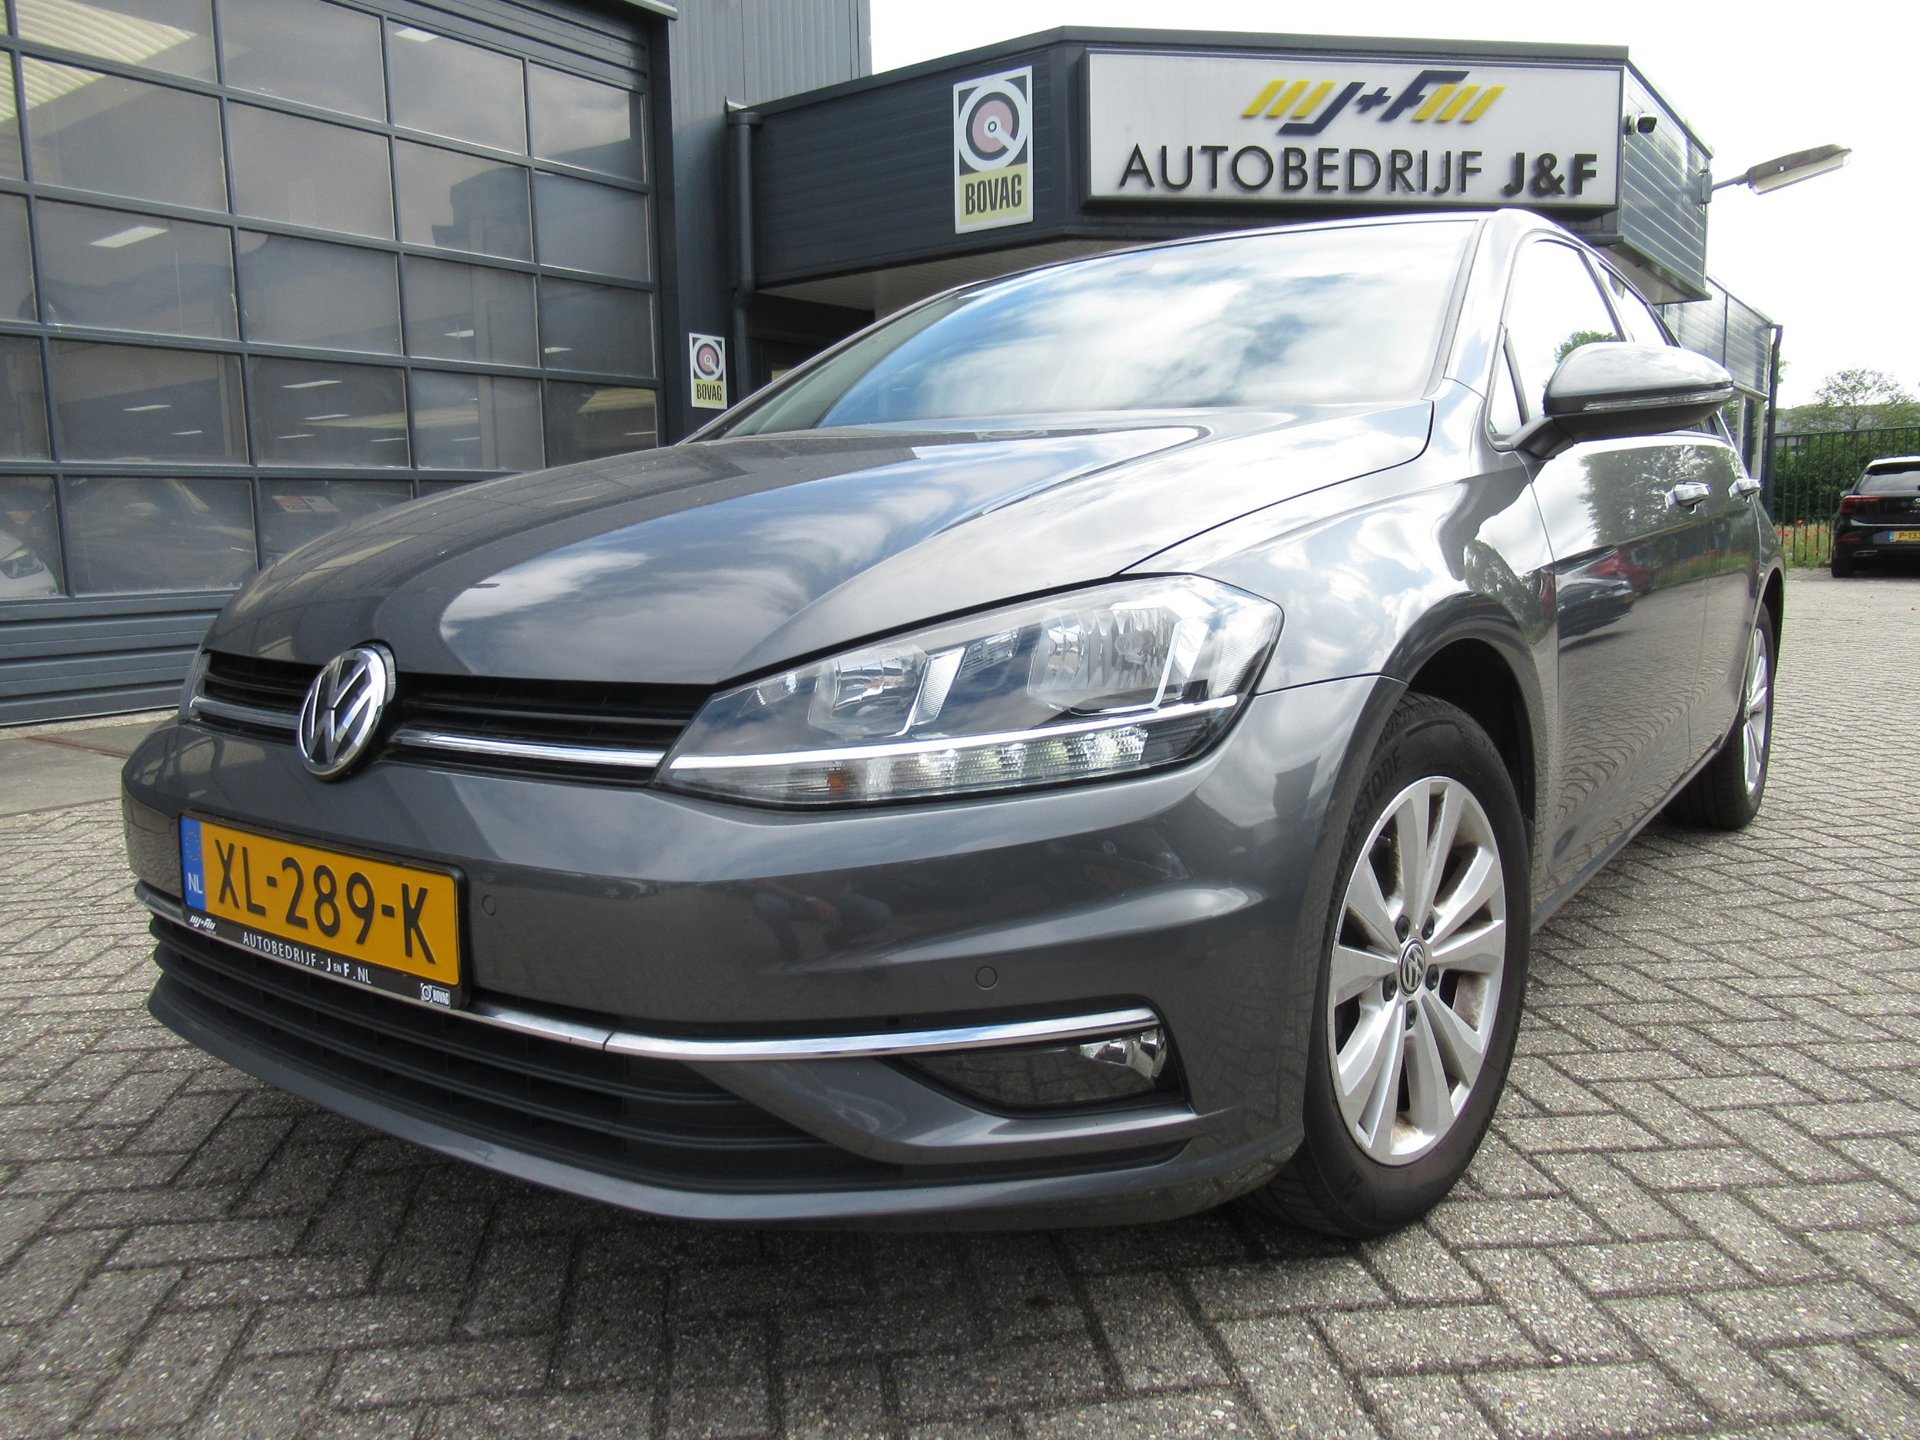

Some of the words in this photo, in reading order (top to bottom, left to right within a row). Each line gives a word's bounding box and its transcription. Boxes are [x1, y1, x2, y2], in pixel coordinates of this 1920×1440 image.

[1118, 142, 1483, 195] AUTOBEDRIJF
[1504, 151, 1598, 197] J&F
[965, 173, 1022, 216] BOVAG
[696, 383, 722, 402] BOVAG
[187, 871, 204, 894] NL
[214, 838, 437, 965] XL-289-K
[242, 931, 317, 967] AUTOBEDRIJF
